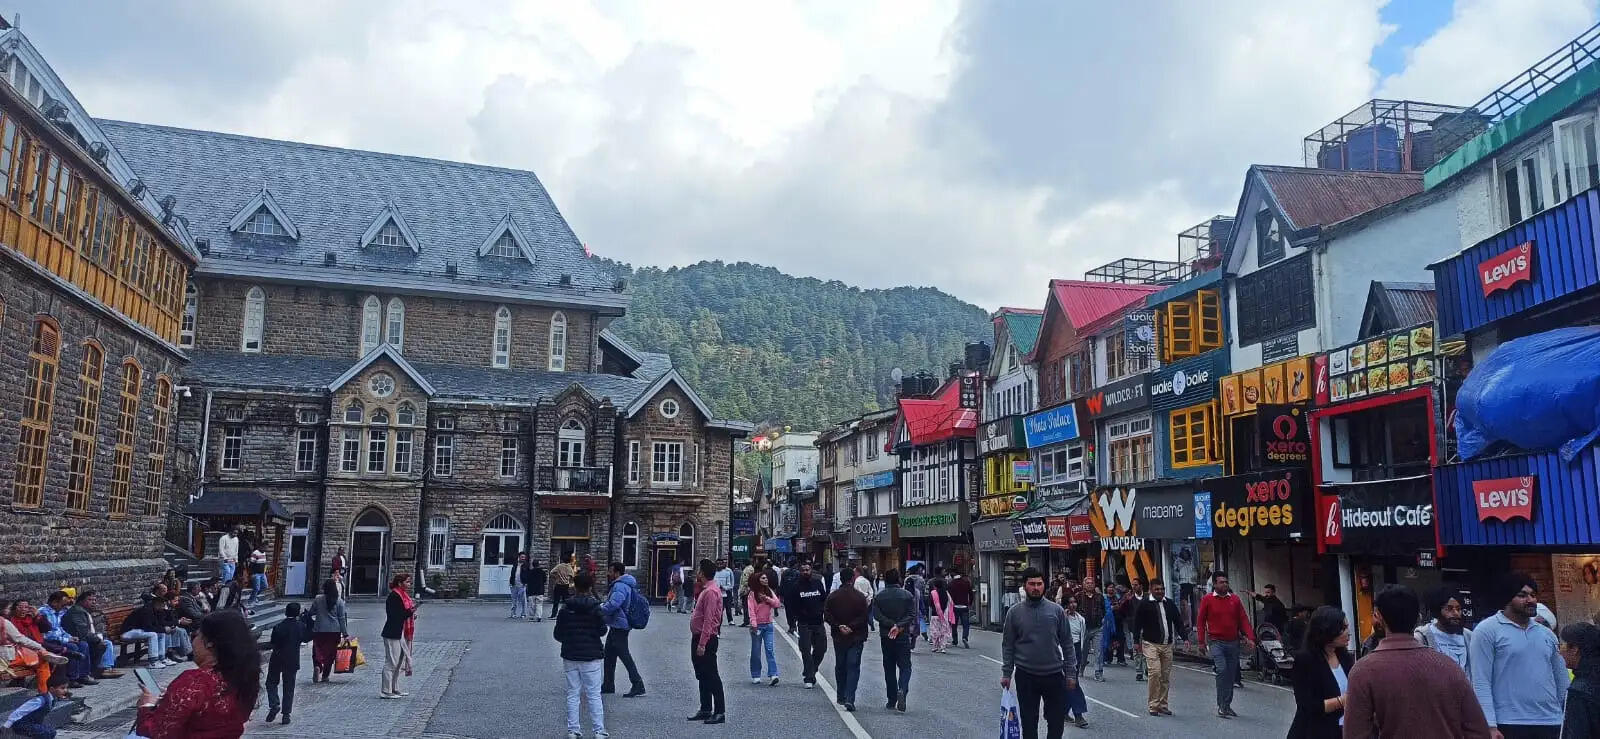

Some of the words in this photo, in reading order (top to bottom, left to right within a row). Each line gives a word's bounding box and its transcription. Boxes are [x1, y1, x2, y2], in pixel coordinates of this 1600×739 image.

[1151, 380, 1173, 395] wake
[1185, 370, 1209, 387] bake
[1048, 409, 1071, 430] Palace
[1266, 440, 1306, 453] xero
[1267, 451, 1307, 463] degrees
[1245, 478, 1291, 503] xero
[1142, 504, 1184, 519] madame
[1214, 501, 1293, 537] degrees
[1342, 507, 1392, 528] Hideout
[1395, 504, 1433, 526] Café
[855, 522, 888, 535] OCTAVE
[1100, 536, 1145, 551] WILDCRAFT
